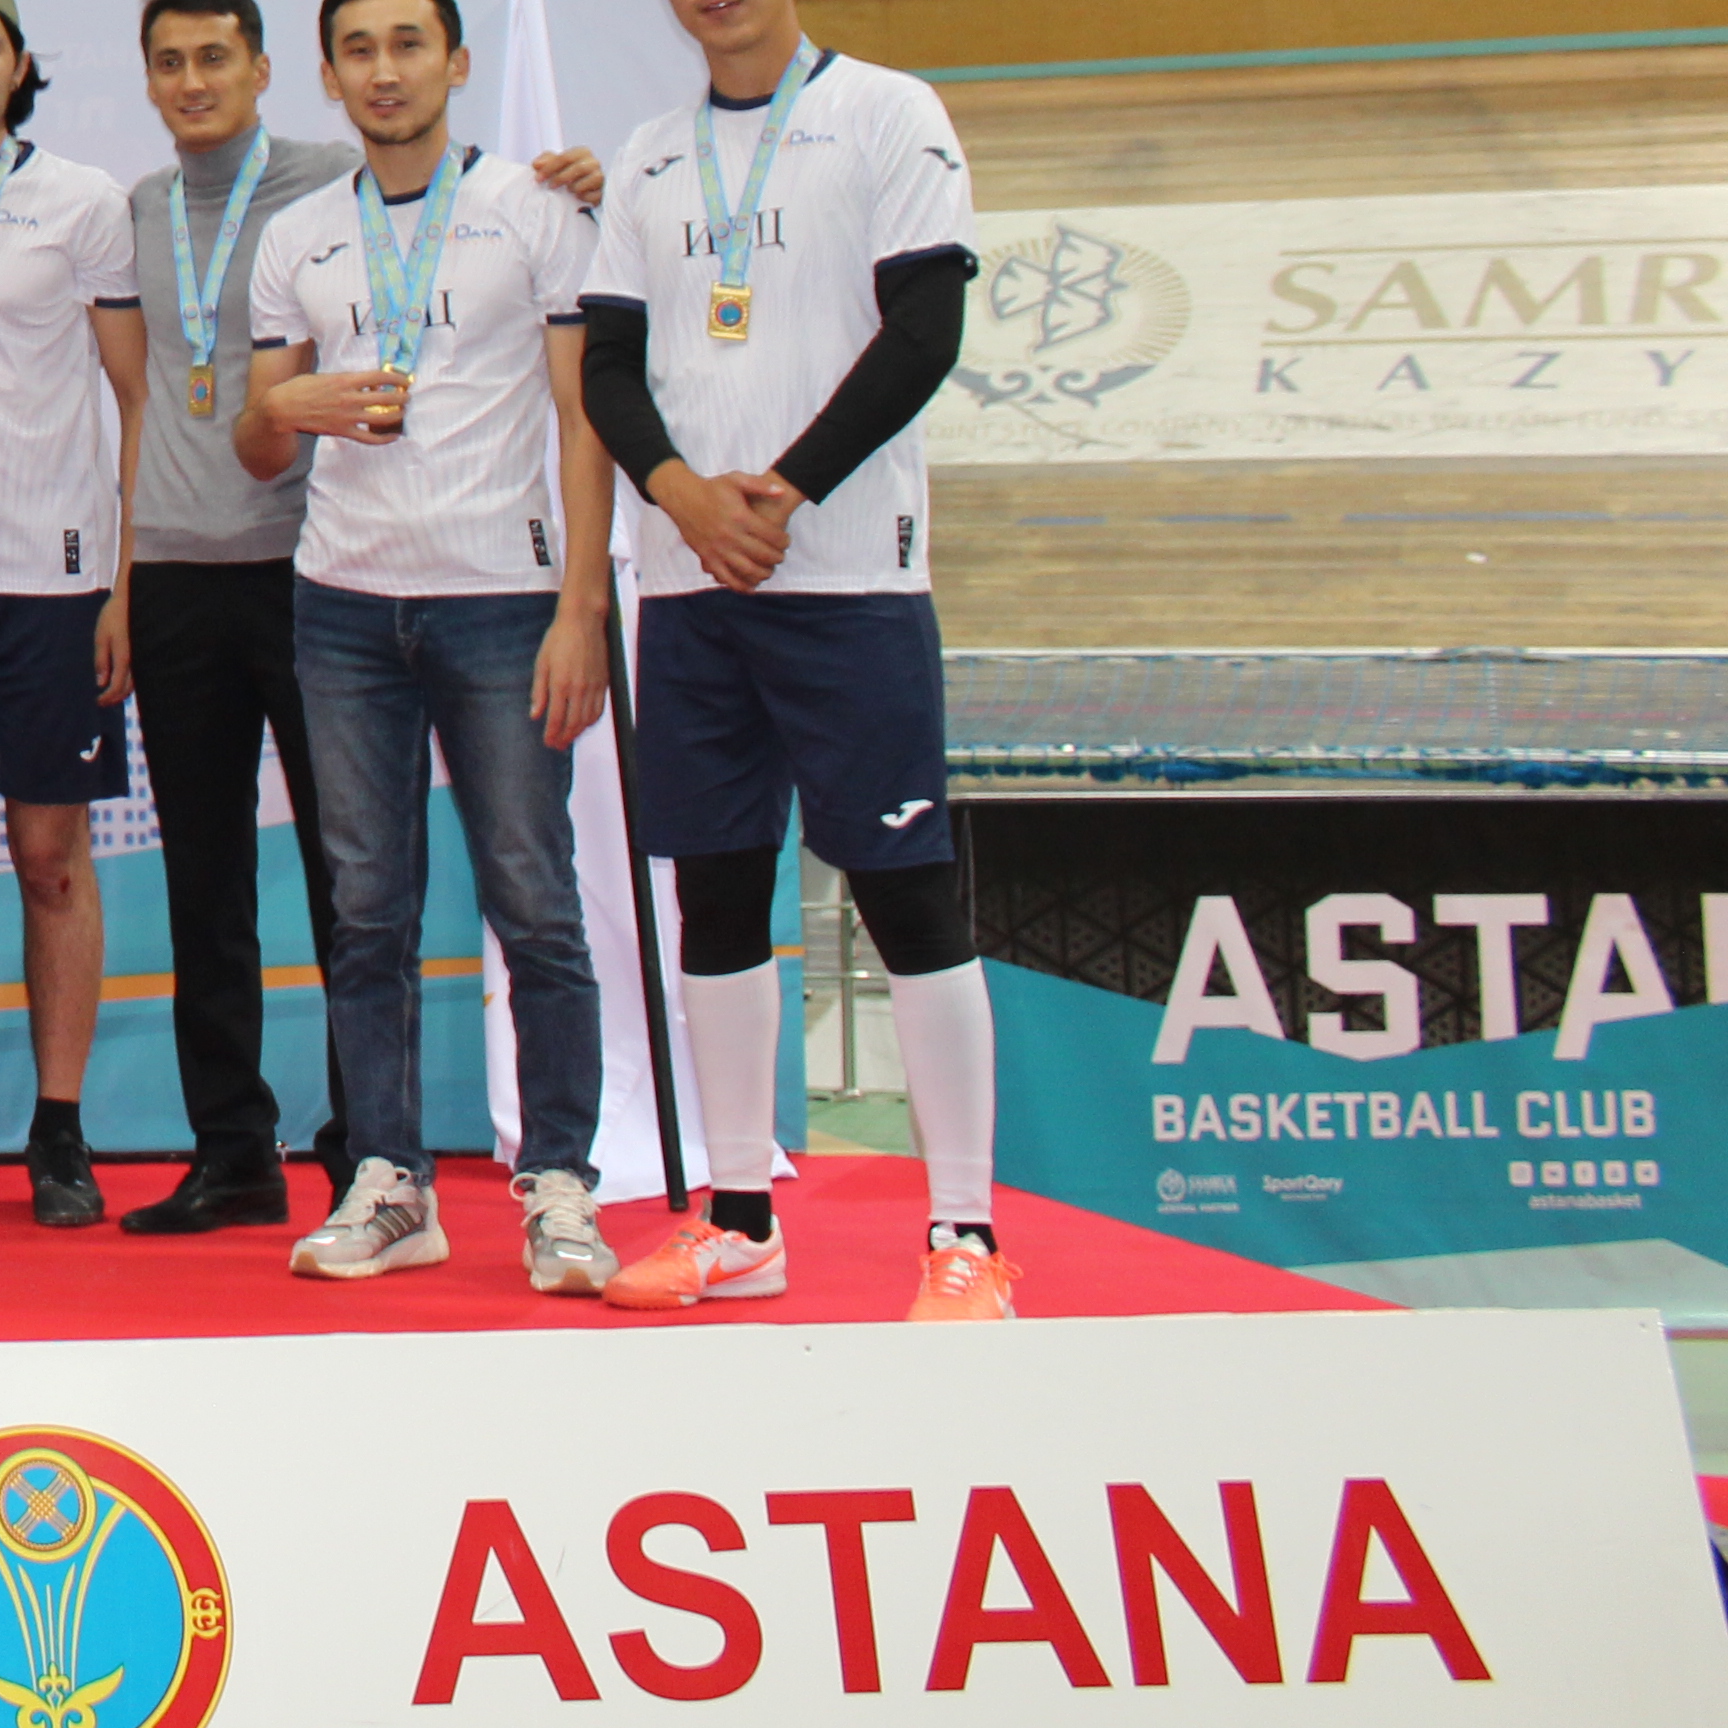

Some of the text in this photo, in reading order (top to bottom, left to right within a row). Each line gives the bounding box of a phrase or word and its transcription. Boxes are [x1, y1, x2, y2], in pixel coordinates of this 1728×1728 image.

[681, 206, 786, 258] ИЦ
[1264, 251, 1728, 335] SAMR
[1152, 1090, 1657, 1142] BASKETBALL CLUB
[411, 1477, 1492, 1705] ASTANA
